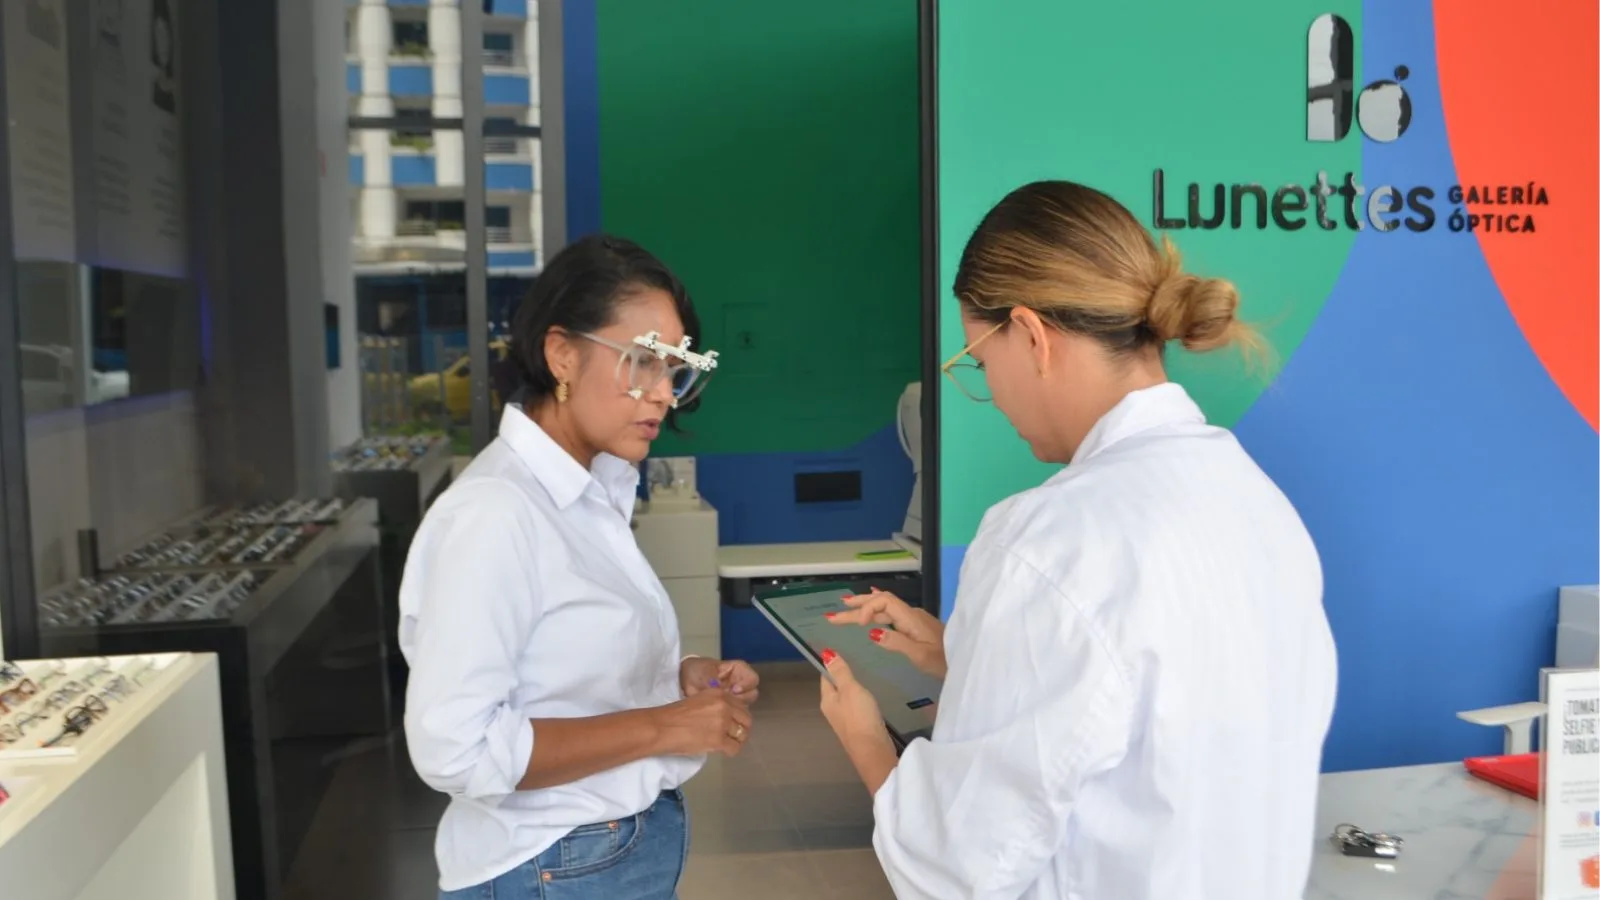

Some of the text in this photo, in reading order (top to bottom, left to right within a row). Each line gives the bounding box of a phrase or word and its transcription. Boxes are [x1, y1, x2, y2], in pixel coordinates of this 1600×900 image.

[1152, 167, 1436, 232] Lunettes
[1447, 181, 1549, 205] GALERÍA
[1447, 208, 1536, 233] ÓPTICA
[1563, 718, 1595, 736] SELFIE
